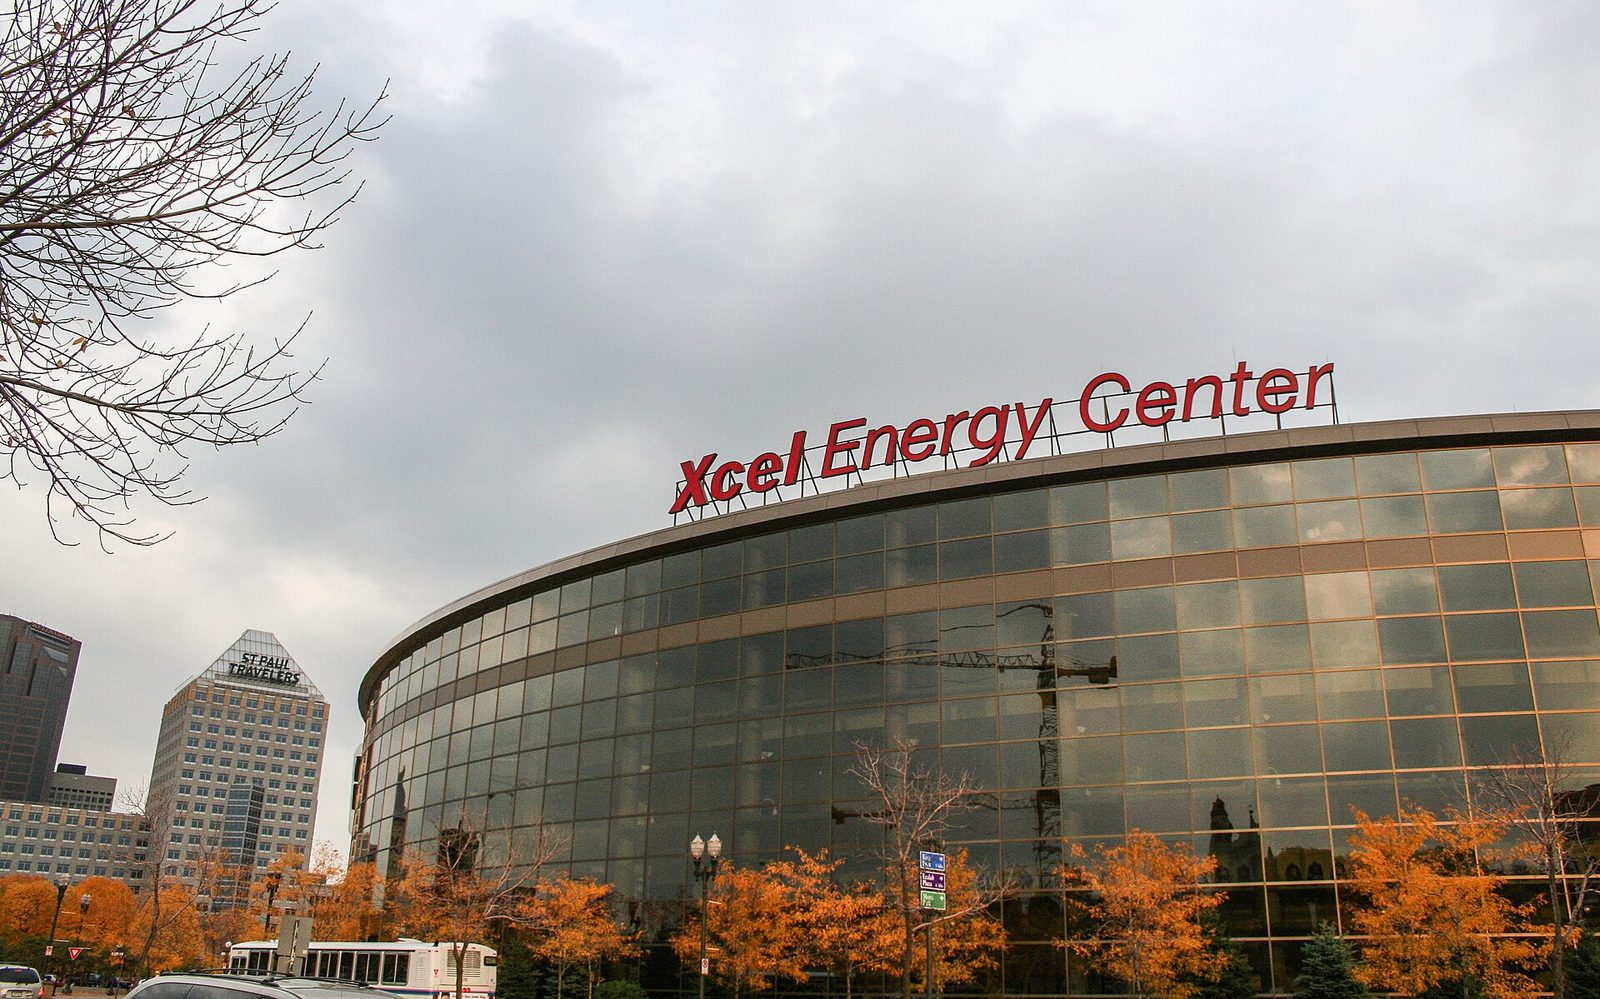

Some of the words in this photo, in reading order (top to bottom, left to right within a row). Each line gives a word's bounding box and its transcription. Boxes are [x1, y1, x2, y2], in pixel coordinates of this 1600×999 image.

[668, 430, 807, 514] Xcel
[821, 397, 1053, 478] Energy
[1079, 361, 1334, 433] Center
[229, 662, 300, 686] TRAVELERS
